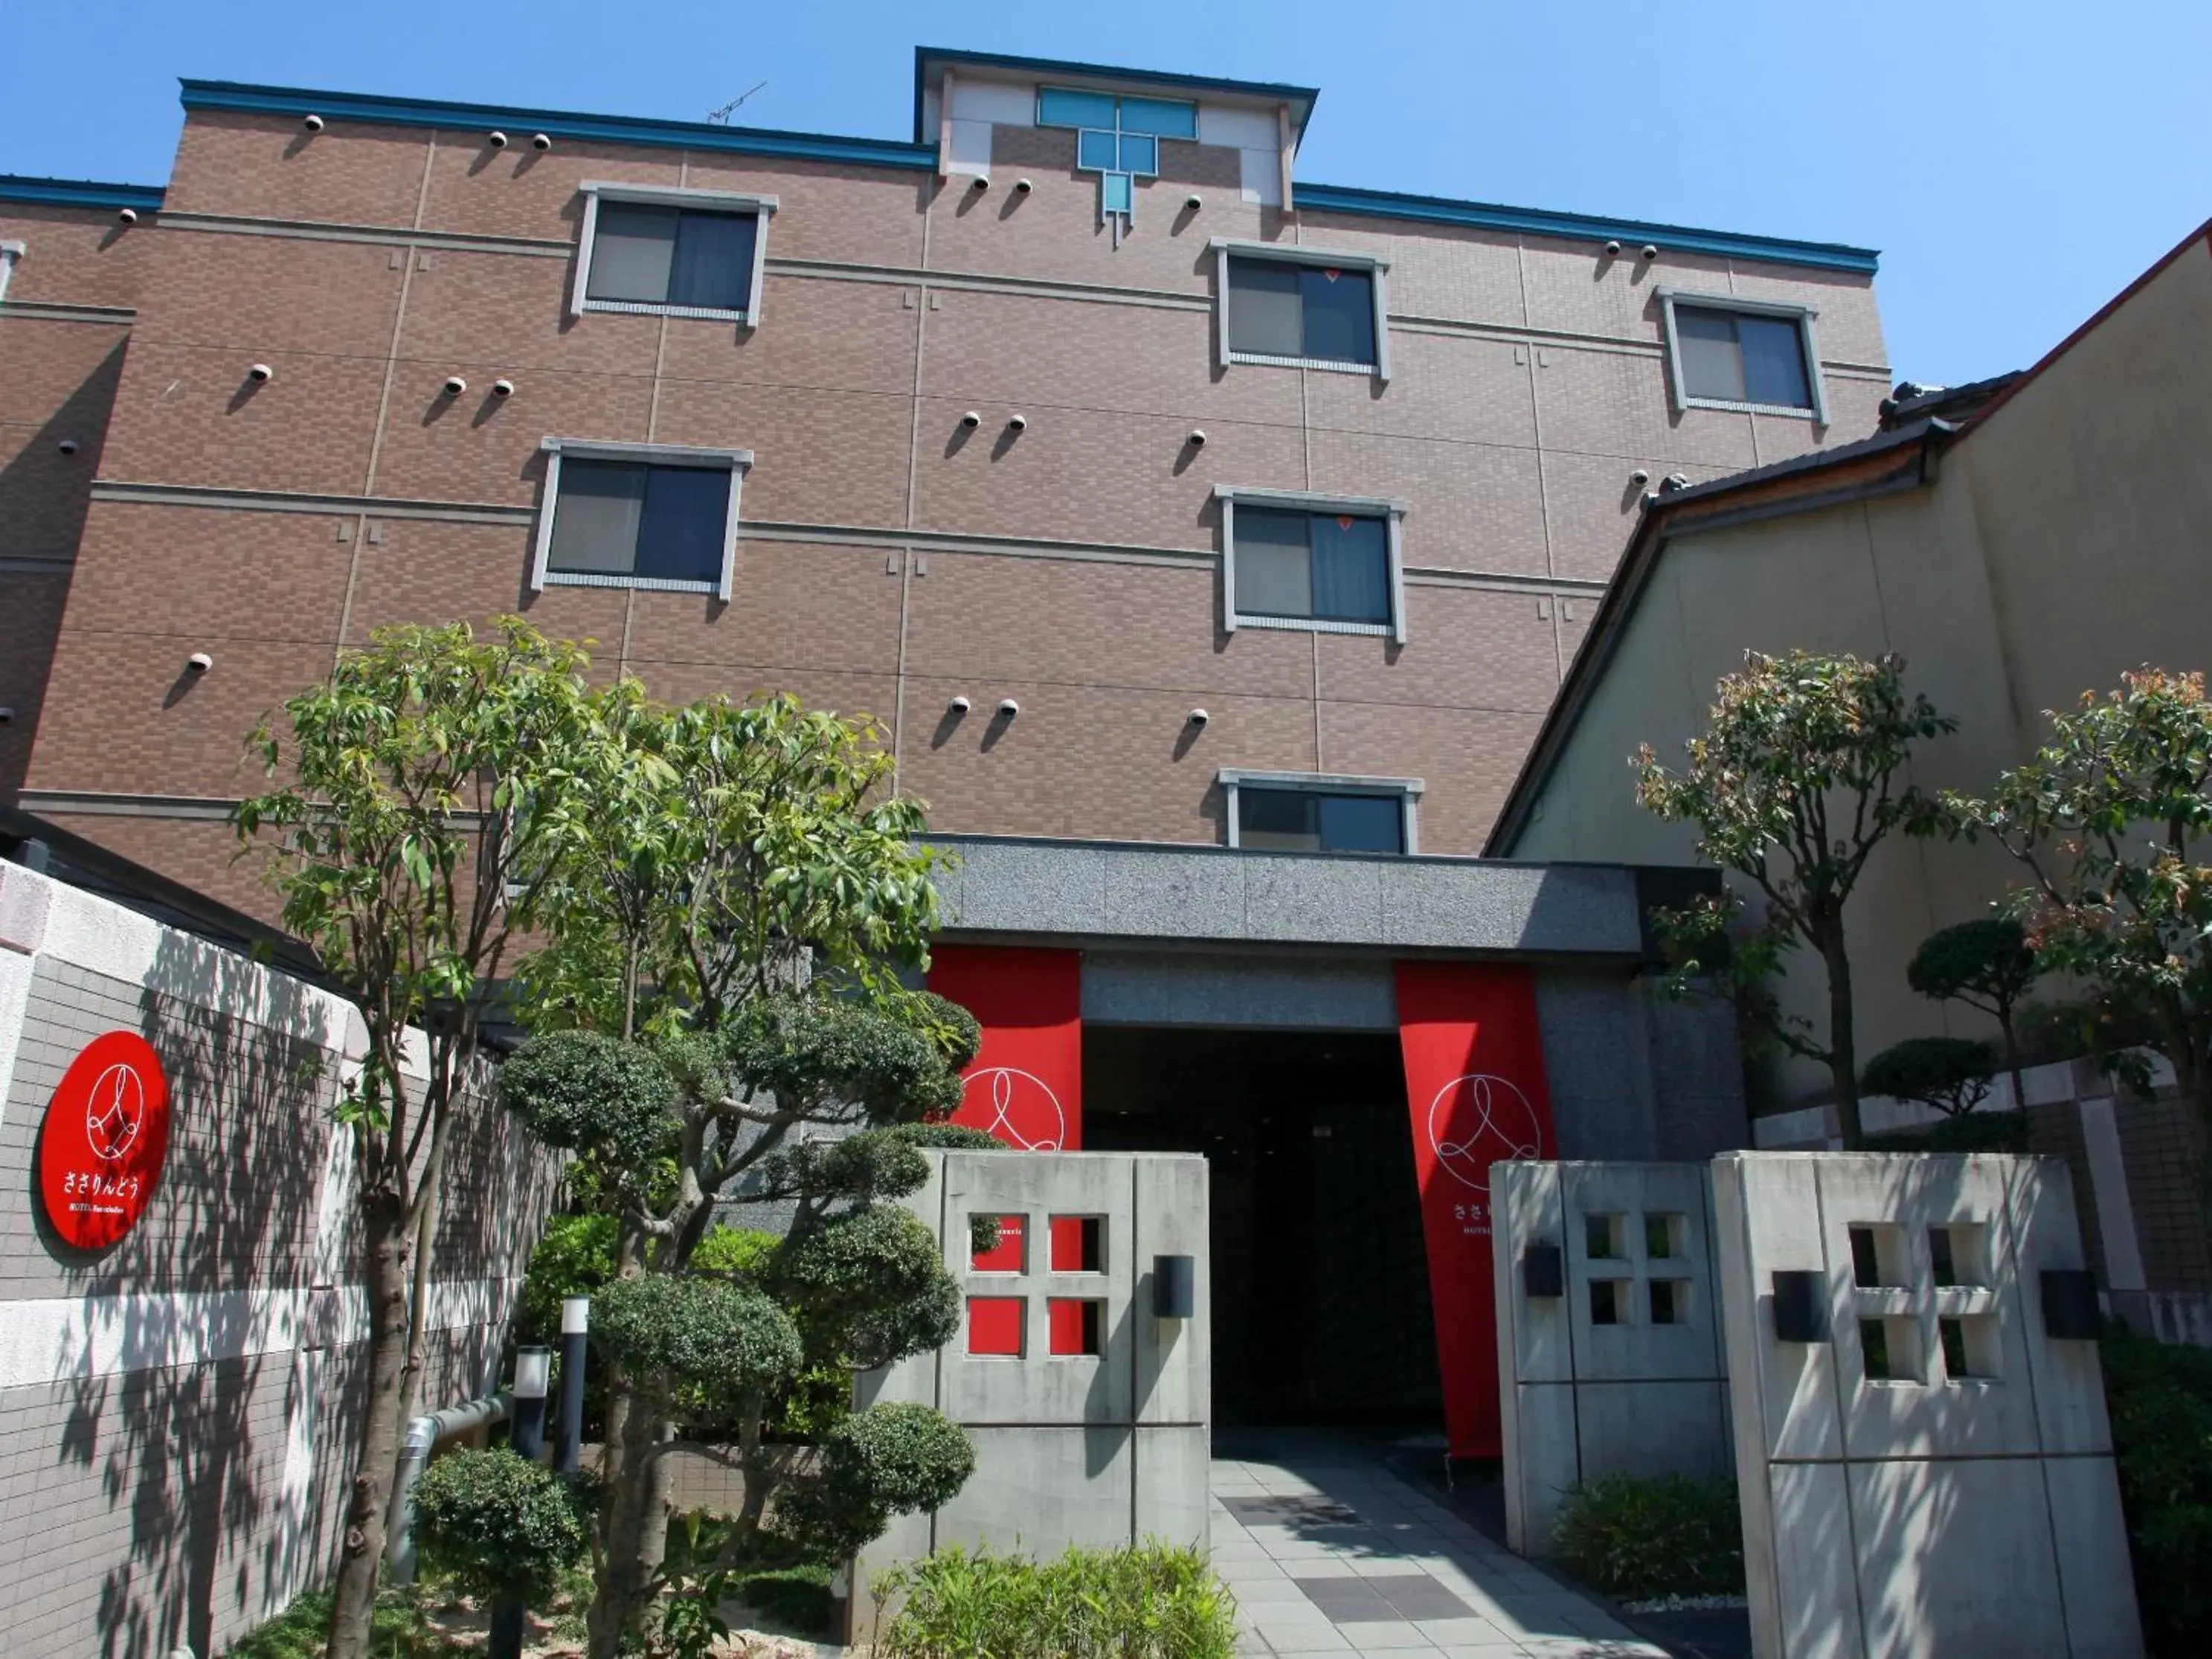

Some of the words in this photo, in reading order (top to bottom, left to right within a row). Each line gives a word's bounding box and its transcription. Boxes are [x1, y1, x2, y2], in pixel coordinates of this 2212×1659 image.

[64, 1171, 138, 1199] ささりんどう
